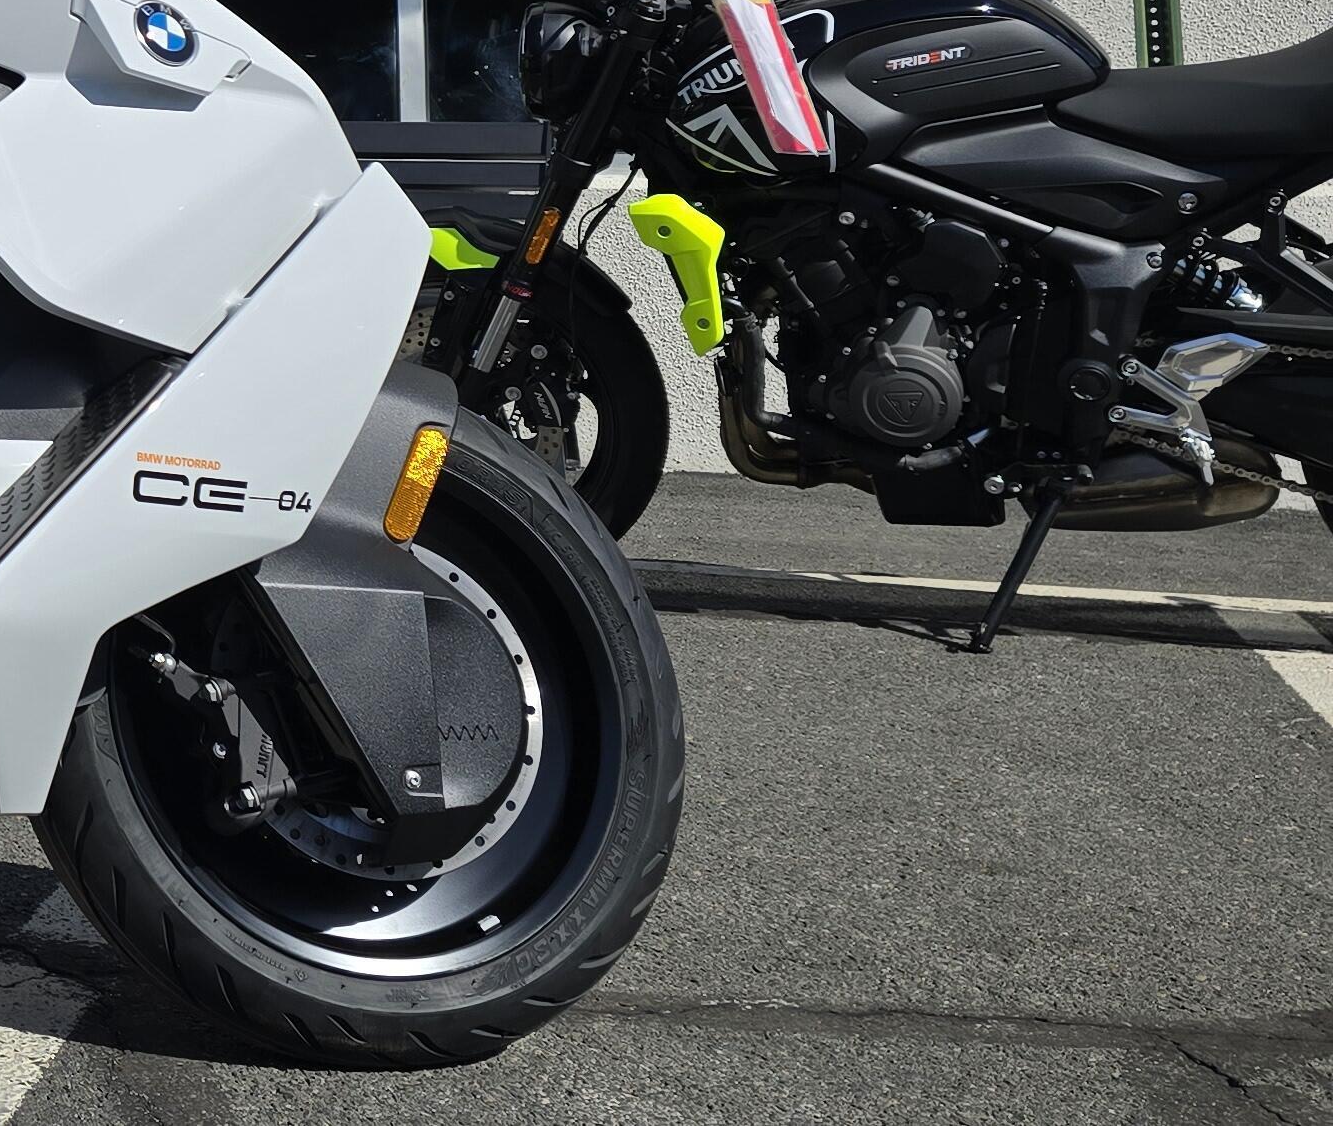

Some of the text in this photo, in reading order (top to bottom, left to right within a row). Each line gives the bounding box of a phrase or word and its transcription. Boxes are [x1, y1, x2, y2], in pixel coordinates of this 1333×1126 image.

[886, 46, 966, 71] TRIDENT
[677, 58, 744, 105] TRIU
[136, 451, 221, 471] BMW MOTORRAD
